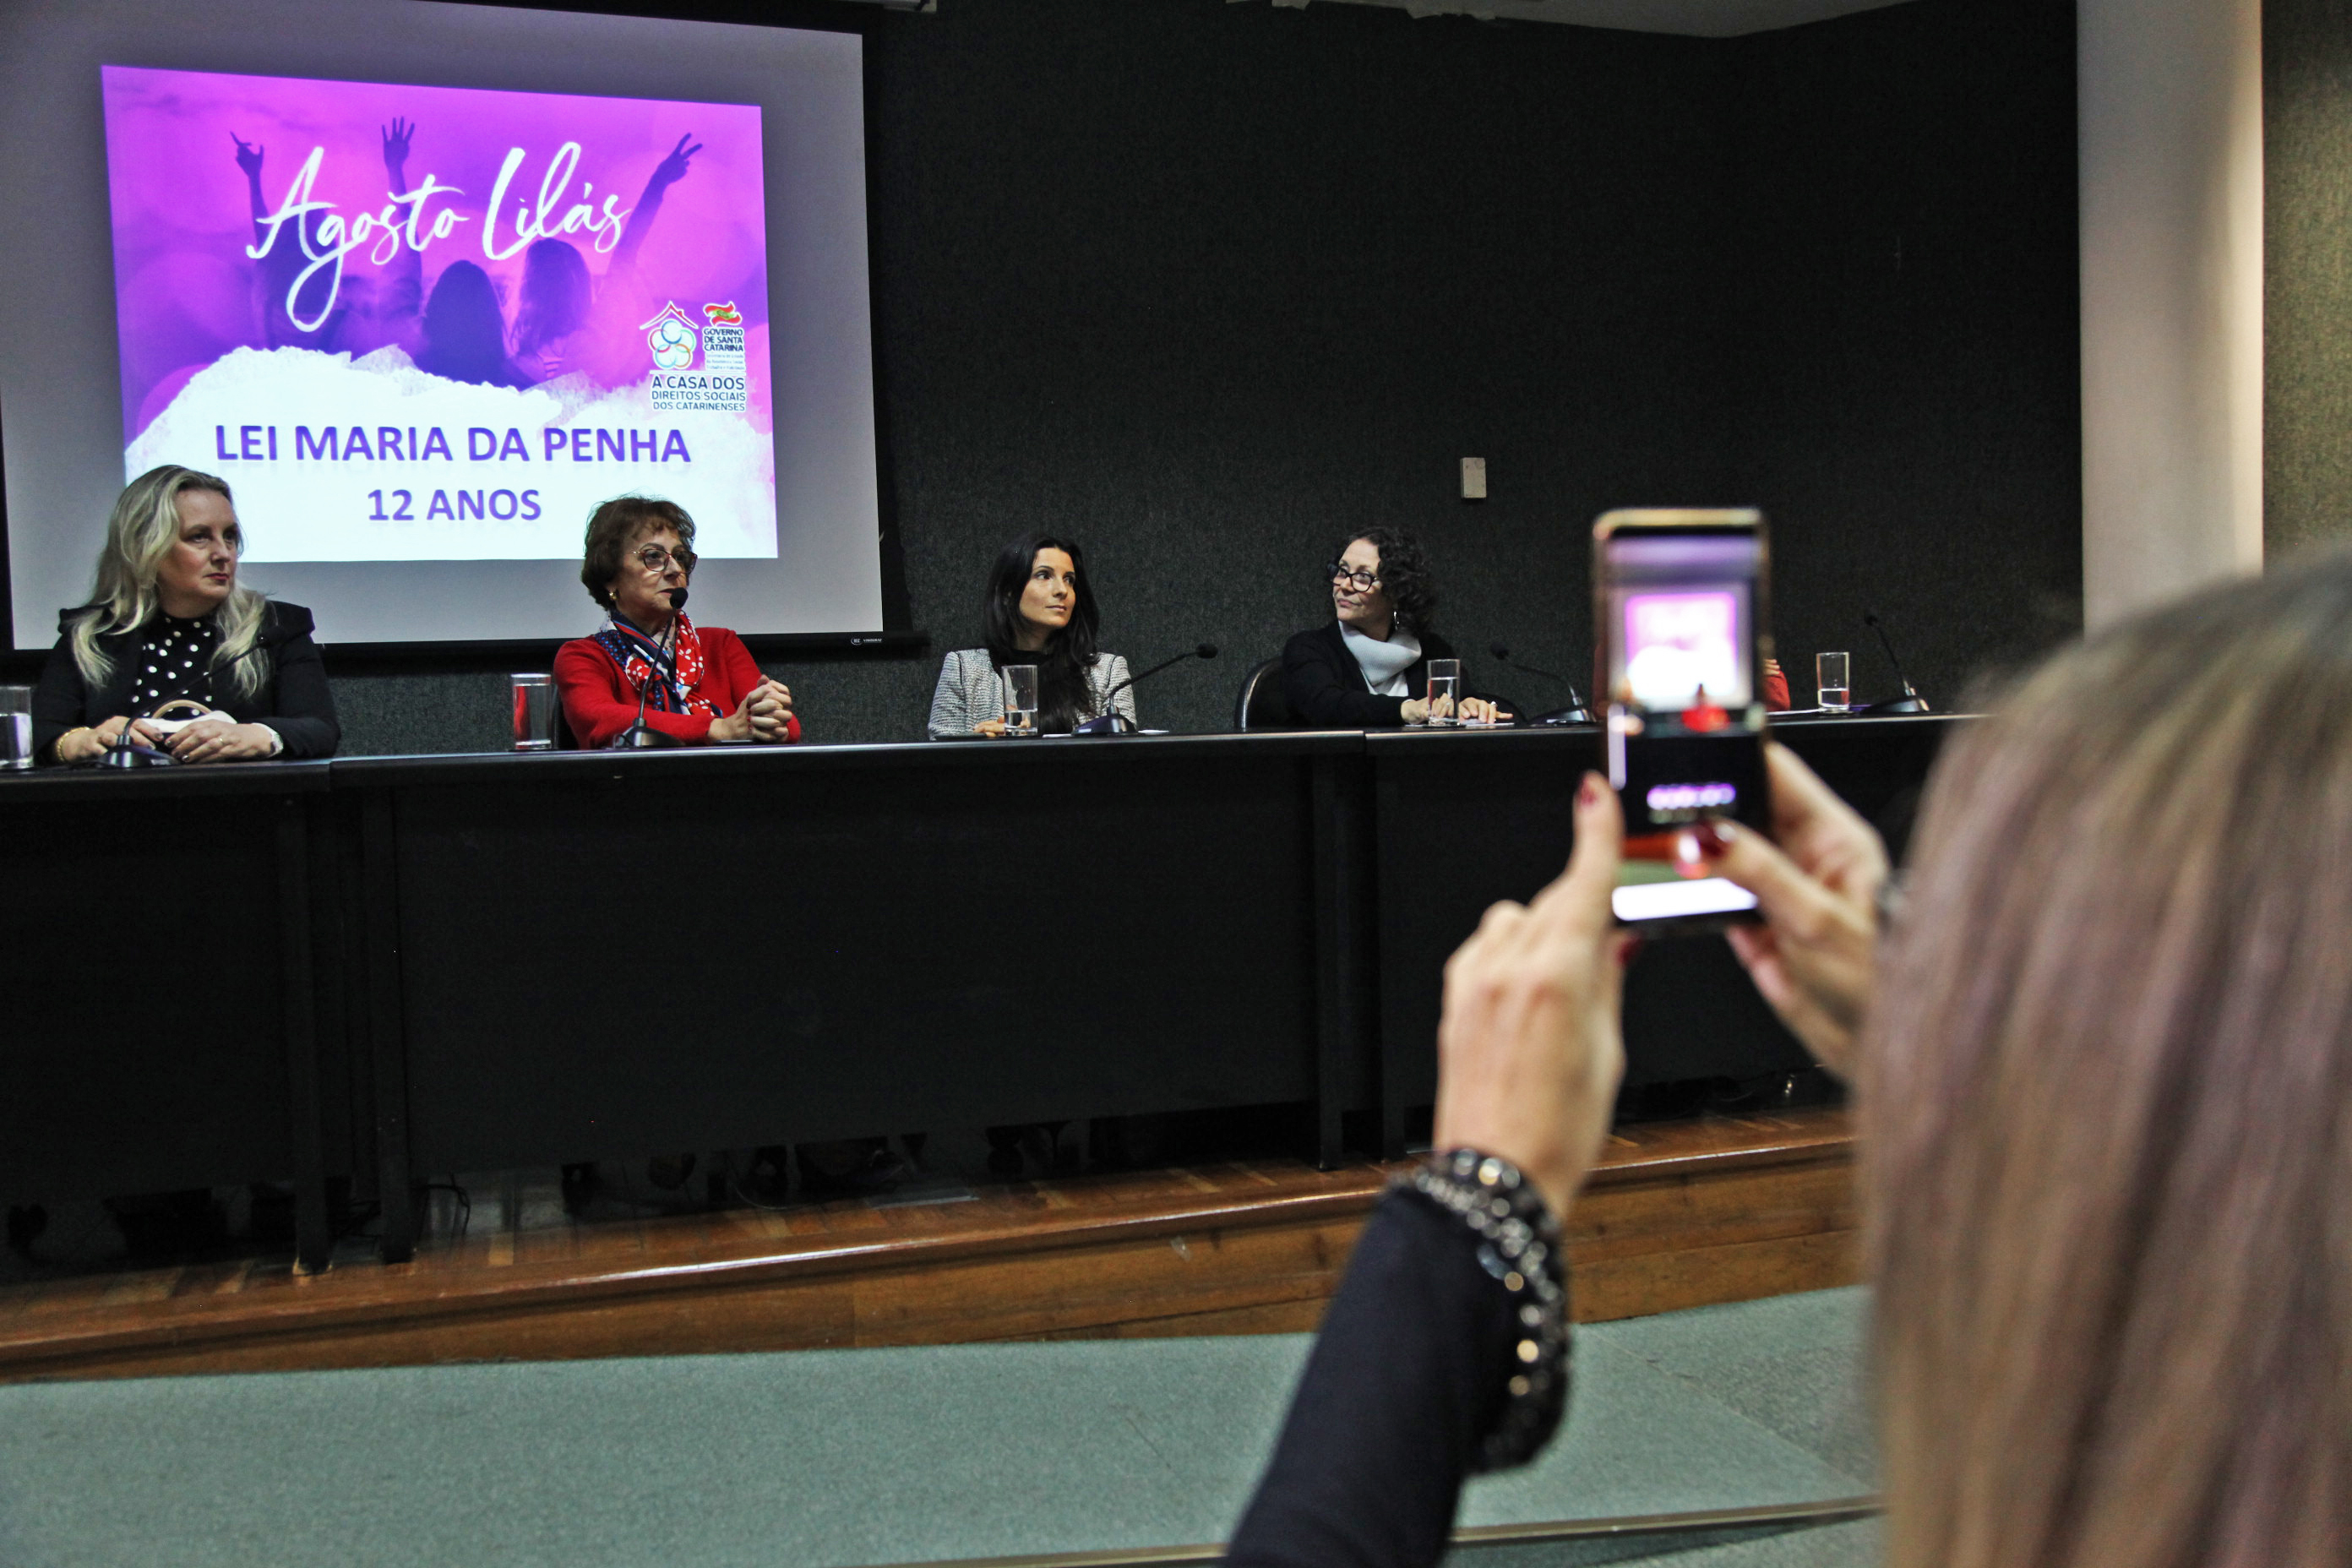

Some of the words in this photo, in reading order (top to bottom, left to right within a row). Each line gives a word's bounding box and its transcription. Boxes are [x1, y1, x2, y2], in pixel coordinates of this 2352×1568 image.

[246, 146, 470, 332] Agosto
[482, 141, 631, 260] Lilás
[704, 328, 743, 336] GOVERNO
[652, 376, 662, 389] A
[667, 376, 708, 389] CASA
[712, 377, 745, 390] DOS
[651, 390, 700, 400] DIREITOS
[704, 391, 746, 401] SOCIAIS
[653, 401, 673, 411] DOS
[676, 402, 745, 411] CATARINENSES
[215, 425, 278, 461] LEI
[295, 425, 454, 461] MARIA
[468, 427, 531, 462] DA
[543, 427, 692, 463] PENHA
[368, 489, 415, 521] 12
[426, 488, 542, 521] ANOS
